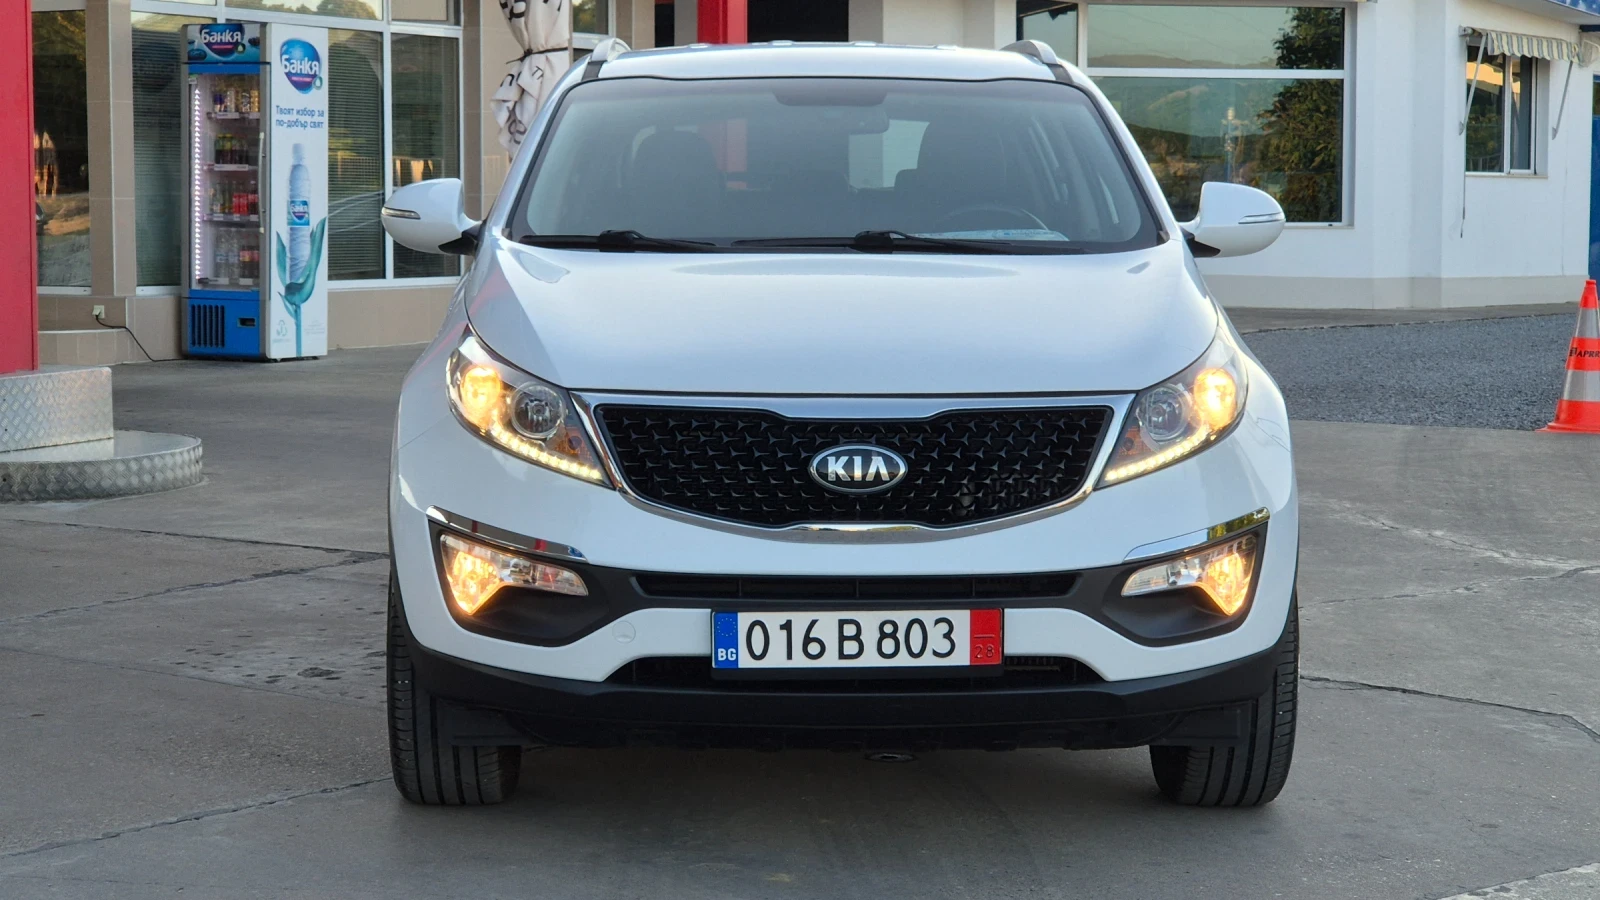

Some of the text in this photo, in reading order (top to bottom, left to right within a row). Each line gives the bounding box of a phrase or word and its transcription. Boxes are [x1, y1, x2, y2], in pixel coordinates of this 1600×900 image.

[276, 105, 294, 115] Твоят
[296, 107, 315, 118] избор
[276, 118, 308, 130] по-добър
[827, 456, 890, 481] KIA
[746, 617, 956, 661] 016 B 803
[717, 648, 737, 661] BG
[974, 645, 994, 658] 28
